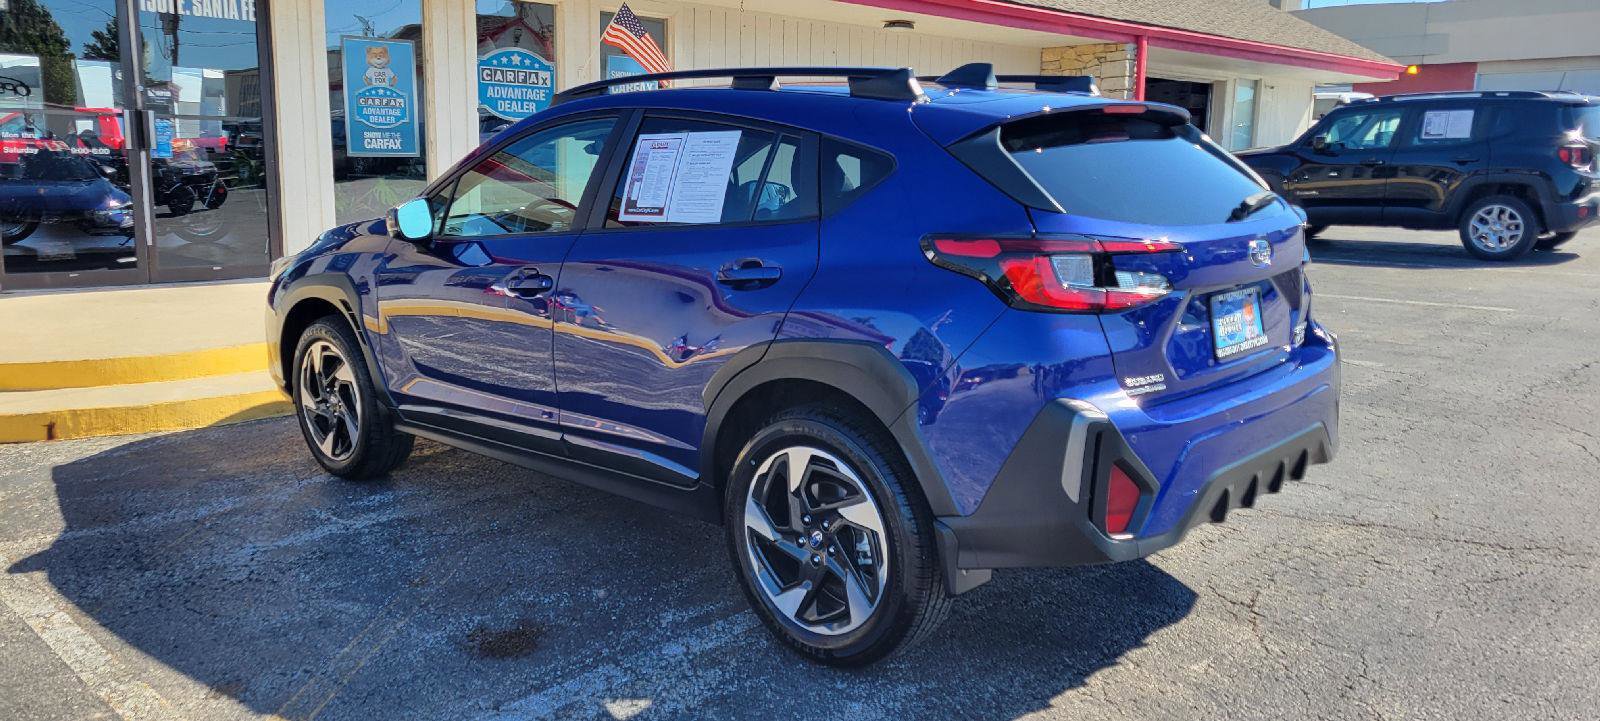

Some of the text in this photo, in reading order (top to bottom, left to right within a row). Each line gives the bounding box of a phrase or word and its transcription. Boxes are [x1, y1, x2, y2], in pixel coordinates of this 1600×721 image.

[192, 0, 239, 20] SANTA
[241, 0, 257, 21] FE
[482, 69, 549, 87] CARFAX
[487, 86, 546, 101] ADVANTAGE
[359, 98, 404, 108] CARFAX
[497, 100, 537, 113] DEALER
[363, 107, 401, 116] ADVANTAGE
[369, 115, 396, 123] DEALER
[363, 131, 381, 139] SHOW
[363, 138, 402, 149] CARFAX
[3, 146, 39, 154] Saturday
